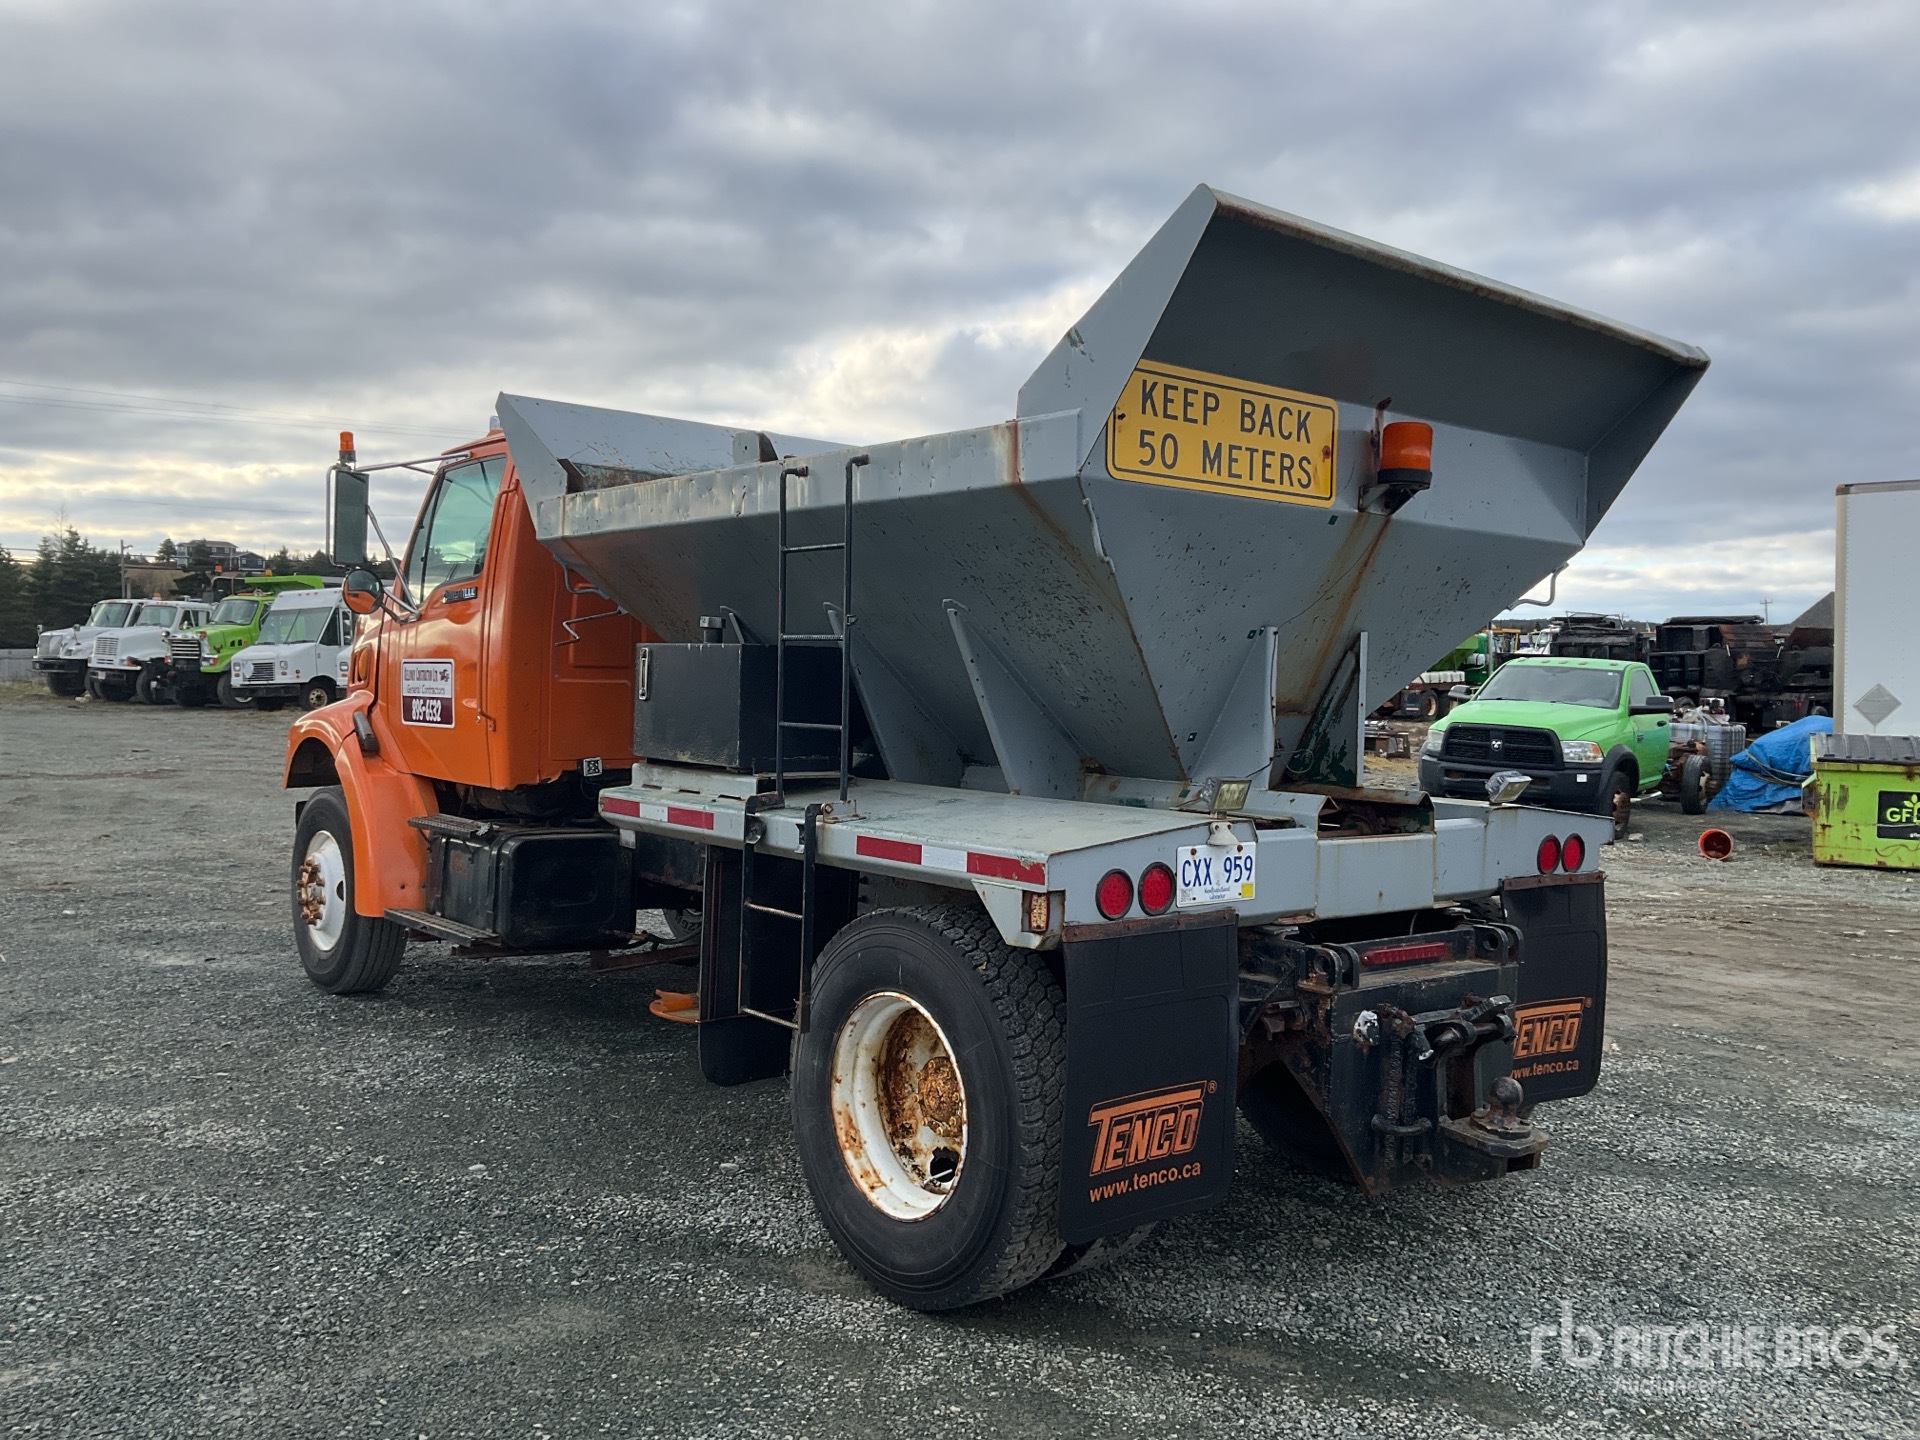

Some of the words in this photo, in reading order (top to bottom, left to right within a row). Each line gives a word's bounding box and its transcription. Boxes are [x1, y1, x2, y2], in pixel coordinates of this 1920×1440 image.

[1141, 379, 1219, 425] KEEP
[1240, 399, 1311, 444] BACK
[1139, 429, 1178, 470] 50
[1202, 440, 1312, 489] METERS
[1182, 857, 1212, 887] CXX
[1224, 855, 1253, 883] 959
[1088, 1080, 1207, 1177] TENCO
[1089, 1162, 1201, 1202] www.tenco.ca
